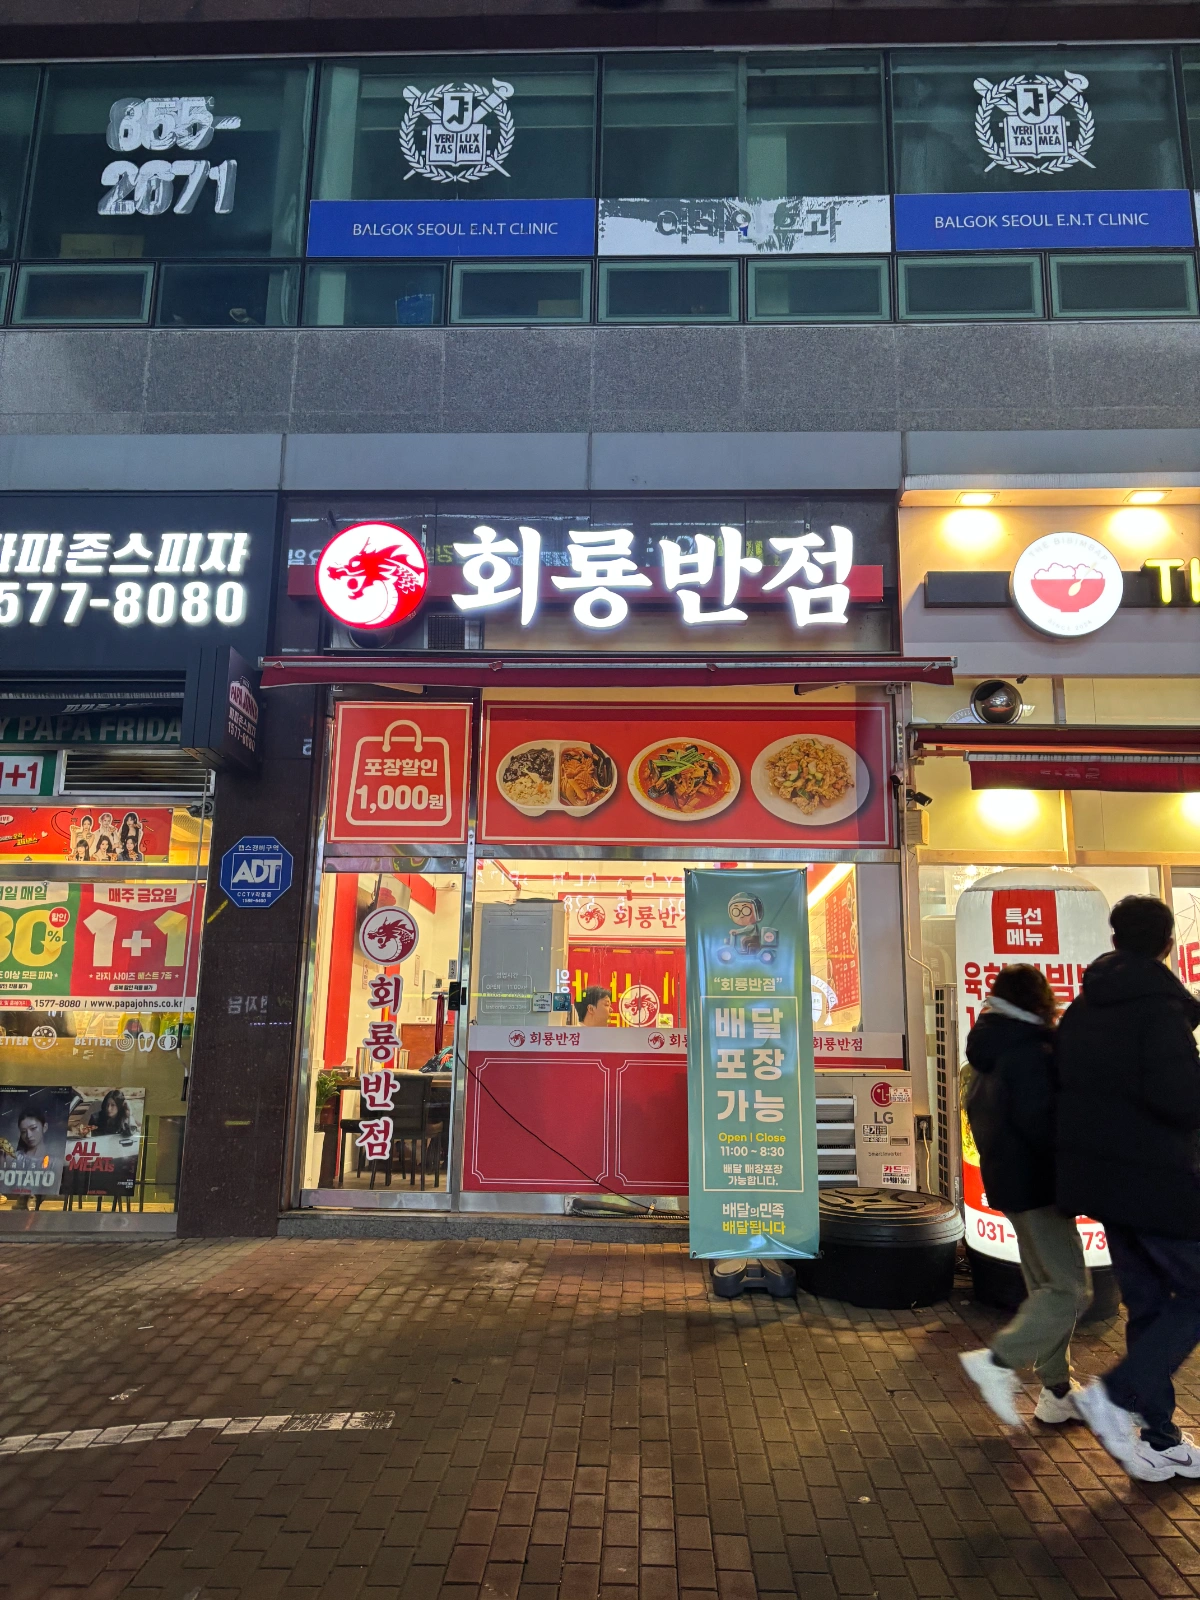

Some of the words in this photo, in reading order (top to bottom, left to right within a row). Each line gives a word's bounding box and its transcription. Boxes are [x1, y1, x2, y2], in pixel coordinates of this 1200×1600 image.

[434, 133, 455, 143] VERI
[460, 133, 480, 143] LUX
[1012, 125, 1033, 135] VERI
[1038, 125, 1059, 135] LUX
[1013, 136, 1033, 146] TAS
[1038, 135, 1062, 145] MEA
[435, 144, 454, 154] TAS
[458, 144, 481, 154] MEA
[353, 223, 414, 236] BALGOK
[417, 223, 465, 236] SEOUL
[470, 222, 507, 235] E.N.T
[509, 222, 559, 235] CLINIC
[935, 215, 999, 229] BALGOK
[1001, 214, 1053, 227] SEOUL
[1057, 213, 1095, 226] E.N.T
[1098, 213, 1150, 226] CLINIC
[1053, 537, 1108, 561] BIBIMBAP
[451, 524, 855, 627] 회룡반점
[17, 715, 92, 741] PAPA
[364, 758, 438, 776] 포장할인
[356, 784, 444, 814] 1,000원
[232, 859, 282, 883] ADT
[20, 885, 48, 901] 매일
[108, 887, 134, 903] 매주
[137, 887, 177, 903] 금요일
[613, 904, 685, 930] 회룡반
[1005, 907, 1043, 926] 특선
[83, 909, 188, 967] 1+1
[1006, 928, 1044, 947] 메뉴
[4, 971, 20, 980] 이상
[22, 971, 37, 980] 모든
[38, 971, 54, 980] 피자
[95, 972, 111, 981] 라지
[113, 972, 136, 981] 사이즈
[137, 971, 159, 980] 베스트
[34, 999, 81, 1008] 1577-8080
[91, 999, 183, 1009] www.papajohns.co.kr
[715, 1007, 784, 1039] 배달
[74, 1037, 112, 1047] BETTER
[529, 1031, 581, 1047] 회룡반점
[812, 1036, 863, 1052] 회룡반점
[357, 976, 402, 1160] 회룡반점
[715, 1049, 785, 1081] 포장
[716, 1089, 785, 1123] 가능
[873, 1111, 894, 1125] LG
[718, 1132, 747, 1144] Open
[755, 1132, 786, 1142] Close
[71, 1142, 100, 1156] ALL
[720, 1145, 748, 1157] 11:00
[759, 1146, 785, 1157] 8:30
[723, 1164, 742, 1174] 배달
[744, 1164, 783, 1175] 매장포장
[728, 1175, 779, 1186] 가능합니다.
[722, 1202, 785, 1219] 배달의민족
[722, 1220, 786, 1235] 배달됩니다
[1081, 1230, 1107, 1251] 73
